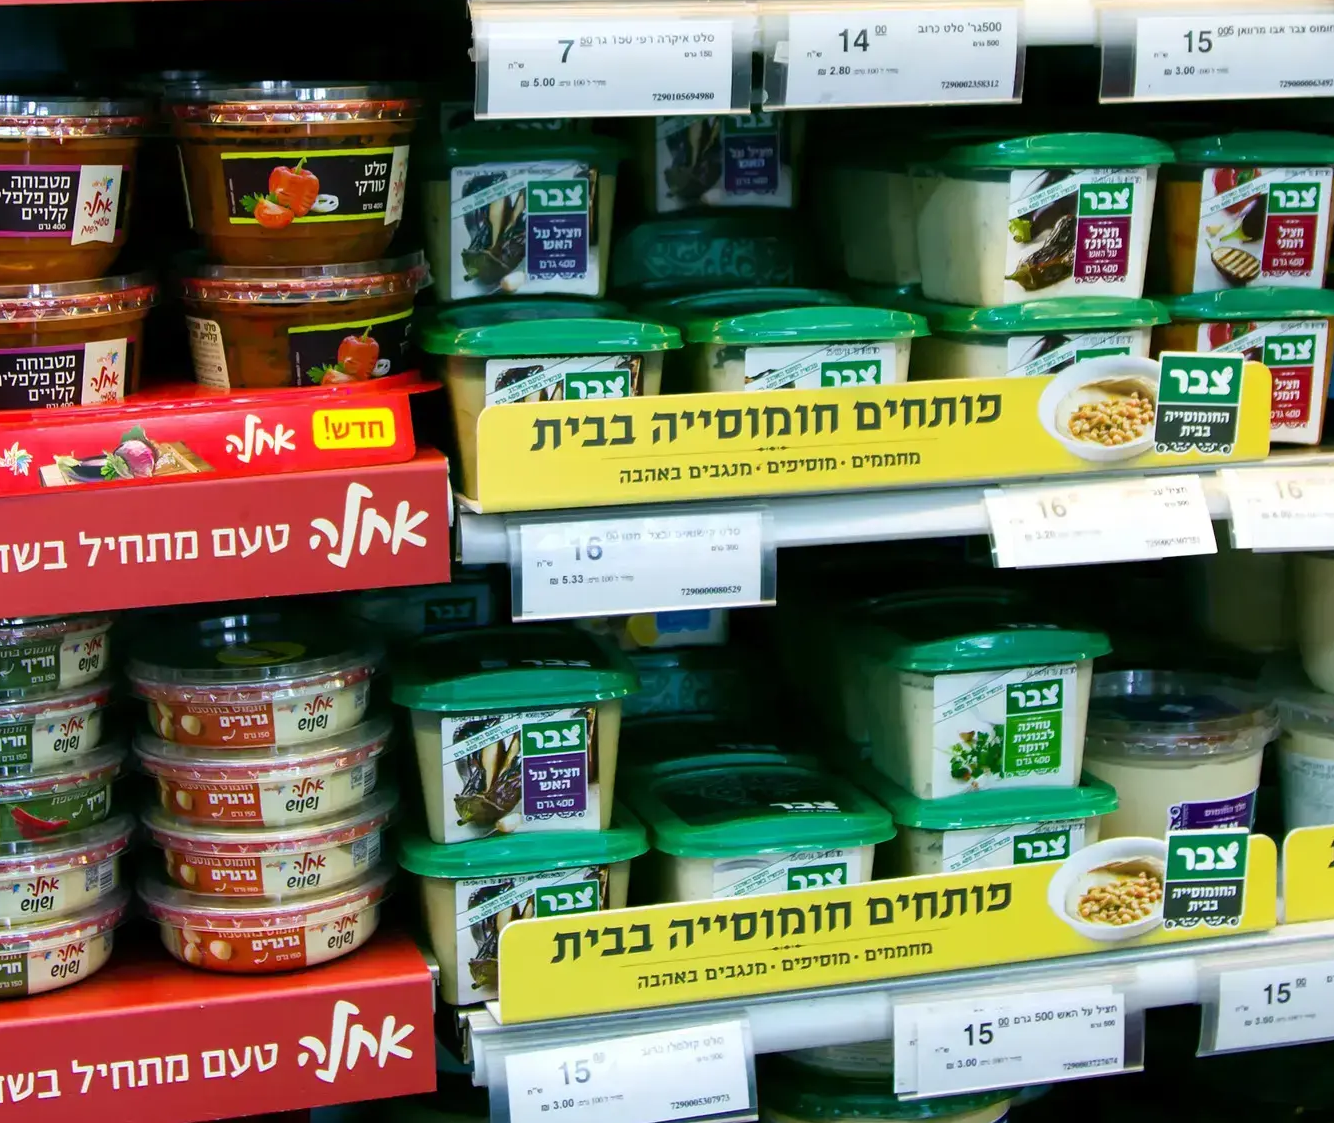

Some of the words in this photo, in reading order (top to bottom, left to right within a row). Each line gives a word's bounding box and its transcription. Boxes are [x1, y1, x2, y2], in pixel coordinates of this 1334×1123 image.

[837, 28, 870, 54] 14
[918, 23, 941, 35] כרוב
[943, 22, 964, 35] סלט
[557, 39, 576, 64] 7
[1182, 30, 1215, 54] 15
[829, 66, 851, 76] 2.80
[10, 175, 70, 189] מטבוחה
[365, 162, 387, 176] סלט
[355, 180, 385, 196] טורקי
[1170, 367, 1233, 394] צבר
[651, 403, 838, 444] חומוסייה
[853, 394, 1001, 430] פותחים
[1165, 411, 1229, 423] החומוסייה
[322, 414, 384, 442] חדש!
[530, 414, 636, 451] בבית
[1180, 426, 1210, 437] בבית
[310, 483, 428, 568] אחלה
[79, 531, 198, 566] מתחיל
[212, 524, 289, 558] טעם
[527, 725, 581, 749] צבר
[540, 779, 570, 791] האש
[866, 883, 1011, 925] פותחים
[668, 902, 851, 950] חומוסייה
[251, 934, 300, 951] גרגרים
[551, 924, 653, 963] בבית
[298, 1001, 414, 1082] אחלה
[963, 1024, 995, 1047] 15
[72, 1055, 188, 1093] מתחיל
[202, 1044, 278, 1078] טעם
